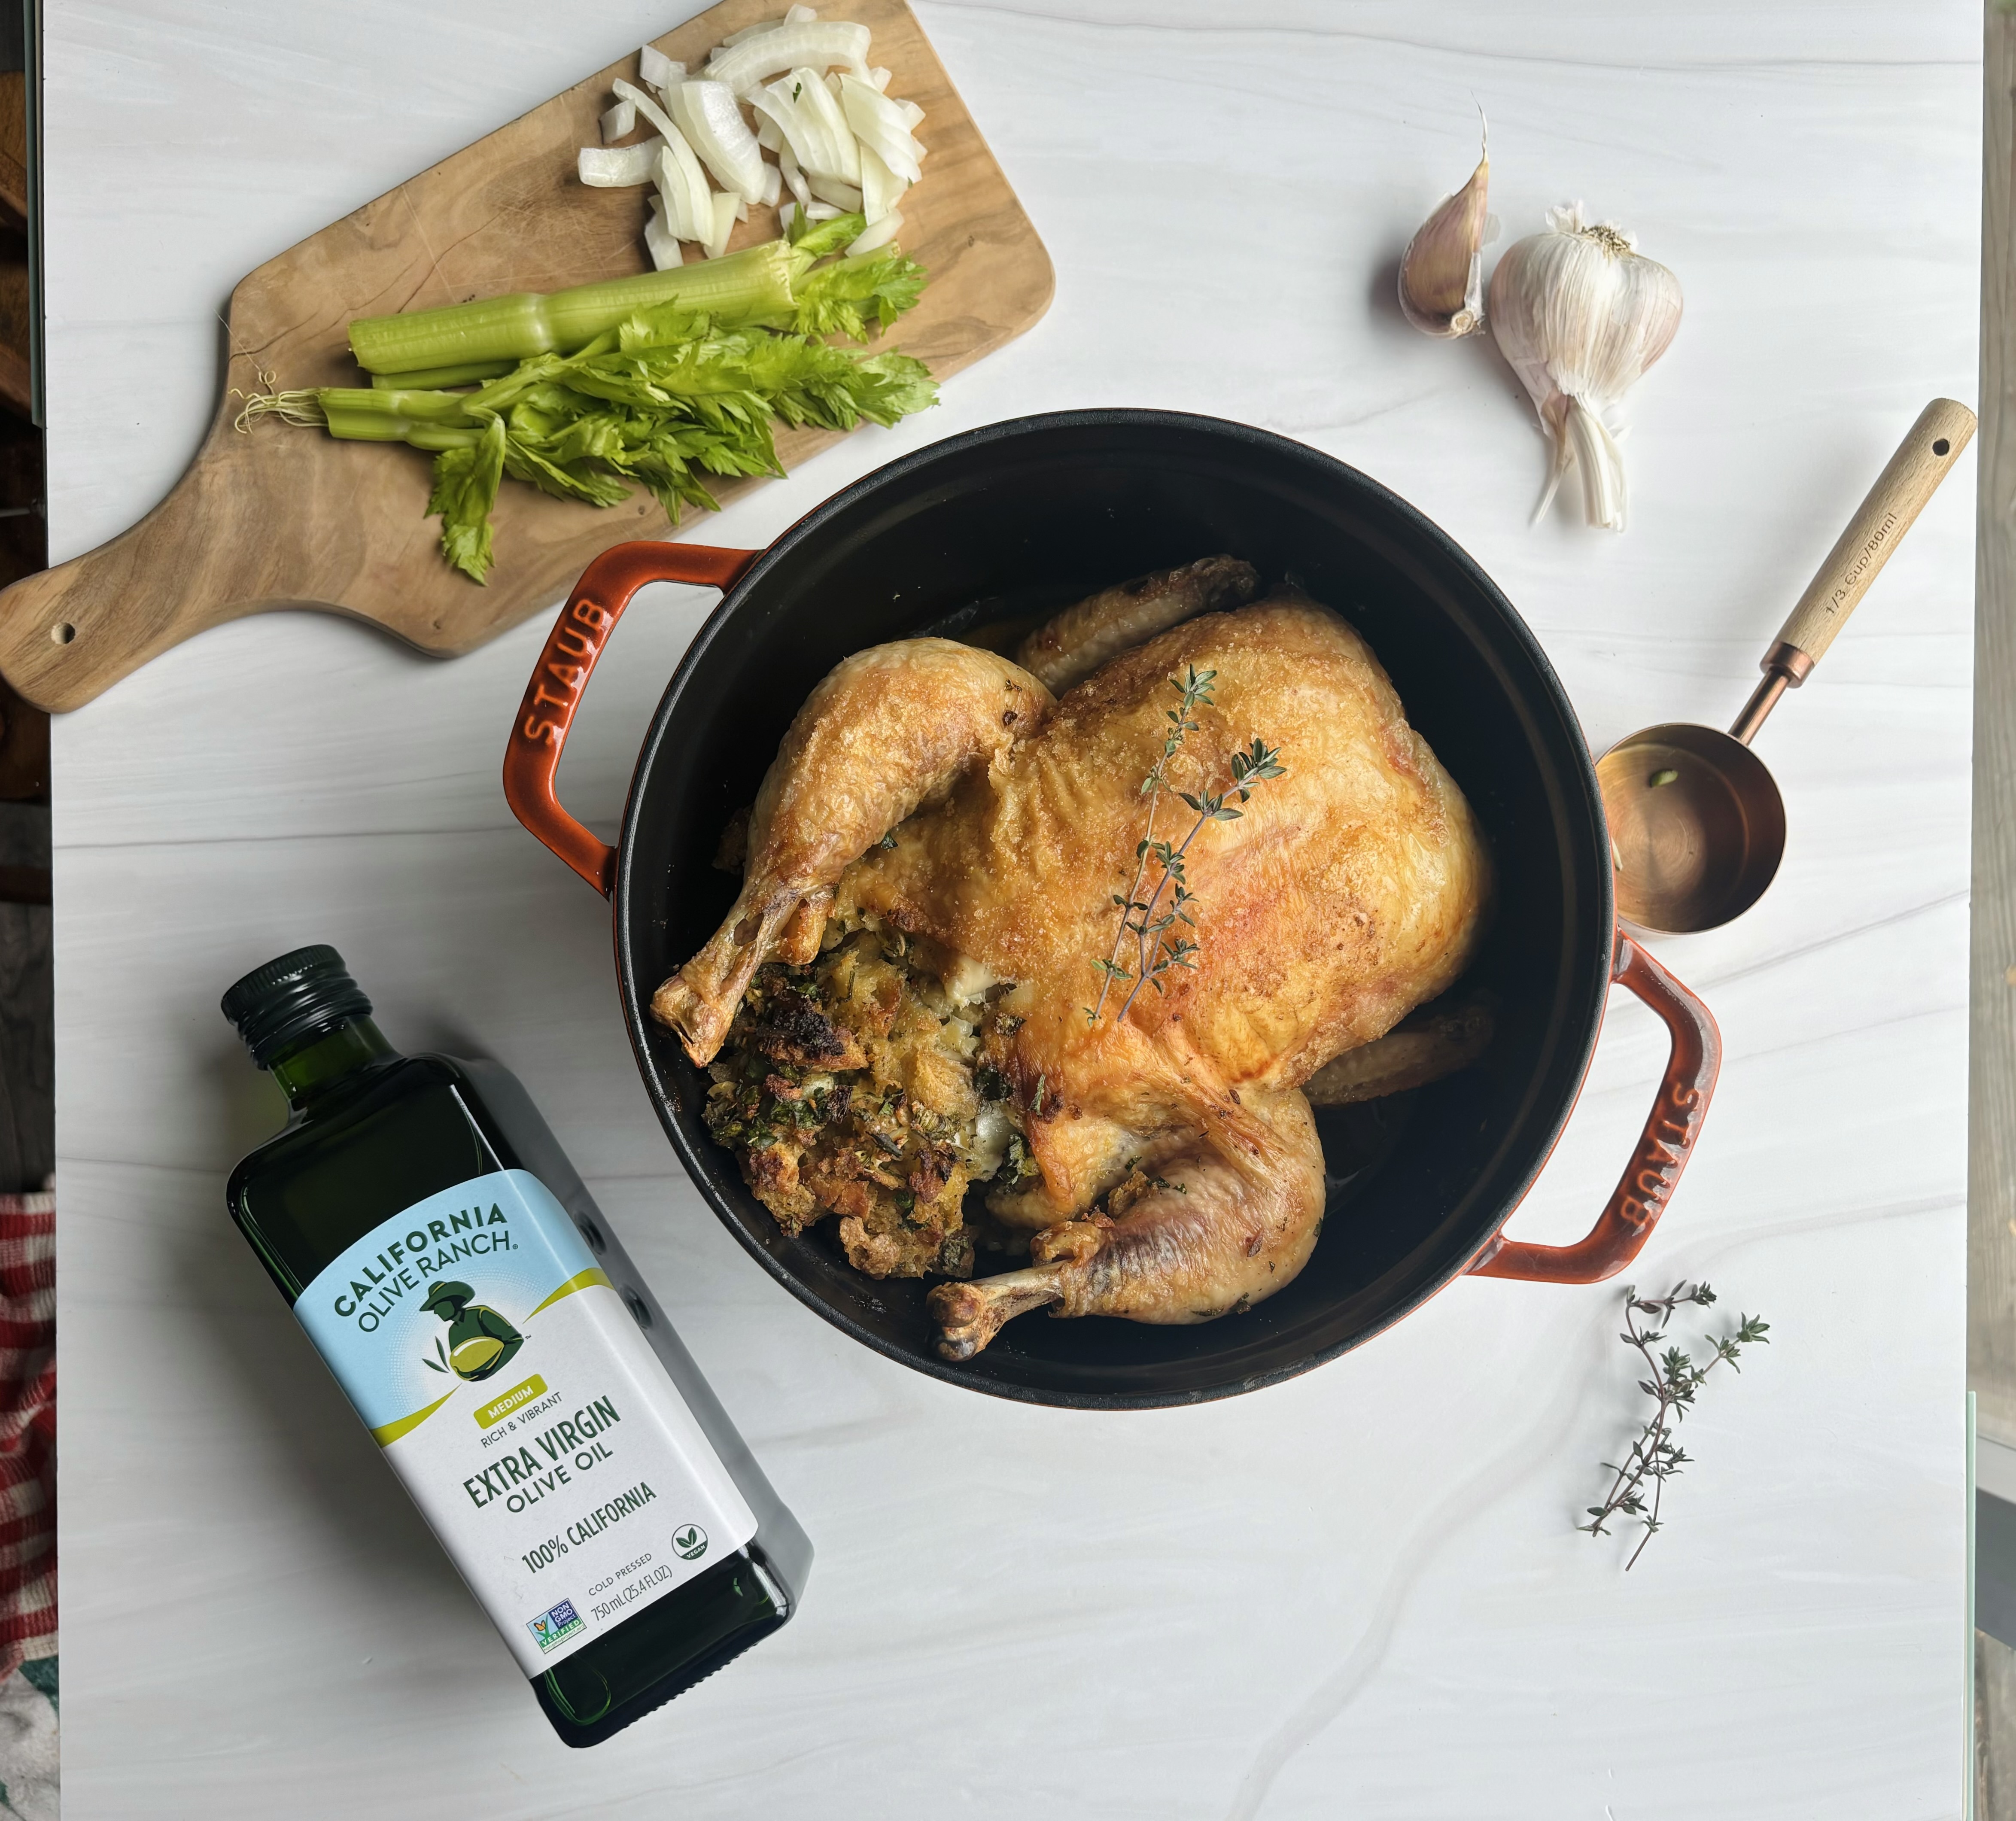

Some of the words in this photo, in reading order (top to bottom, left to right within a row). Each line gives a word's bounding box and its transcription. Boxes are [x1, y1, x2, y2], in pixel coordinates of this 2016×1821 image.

[1826, 589, 1846, 614] 1/3
[524, 599, 605, 747] STAUB
[1620, 1082, 1700, 1226] STAUB
[334, 1203, 508, 1316] CALIFORNIA
[359, 1268, 420, 1332] OLIVE
[480, 1427, 507, 1448] RICH
[508, 1422, 517, 1431] &
[517, 1392, 562, 1424] VIBRANT
[487, 1386, 534, 1419] MEDIUM
[463, 1446, 543, 1508] EXTRA
[535, 1395, 621, 1461] VIRGIN
[507, 1465, 572, 1513] OLIVE
[575, 1442, 614, 1470] OIL
[522, 1535, 569, 1574] 100%
[566, 1481, 657, 1546] CALIFORNIA
[687, 1544, 705, 1558] VEGAN
[589, 1577, 614, 1596] COLD
[615, 1553, 652, 1580] PRESSED
[551, 1603, 569, 1617] NON
[555, 1608, 572, 1623] GMO
[558, 1614, 576, 1627] Project
[591, 1602, 611, 1621] 750
[542, 1620, 579, 1645] VERIFIED
[544, 1625, 585, 1651] nongmoproject.org
